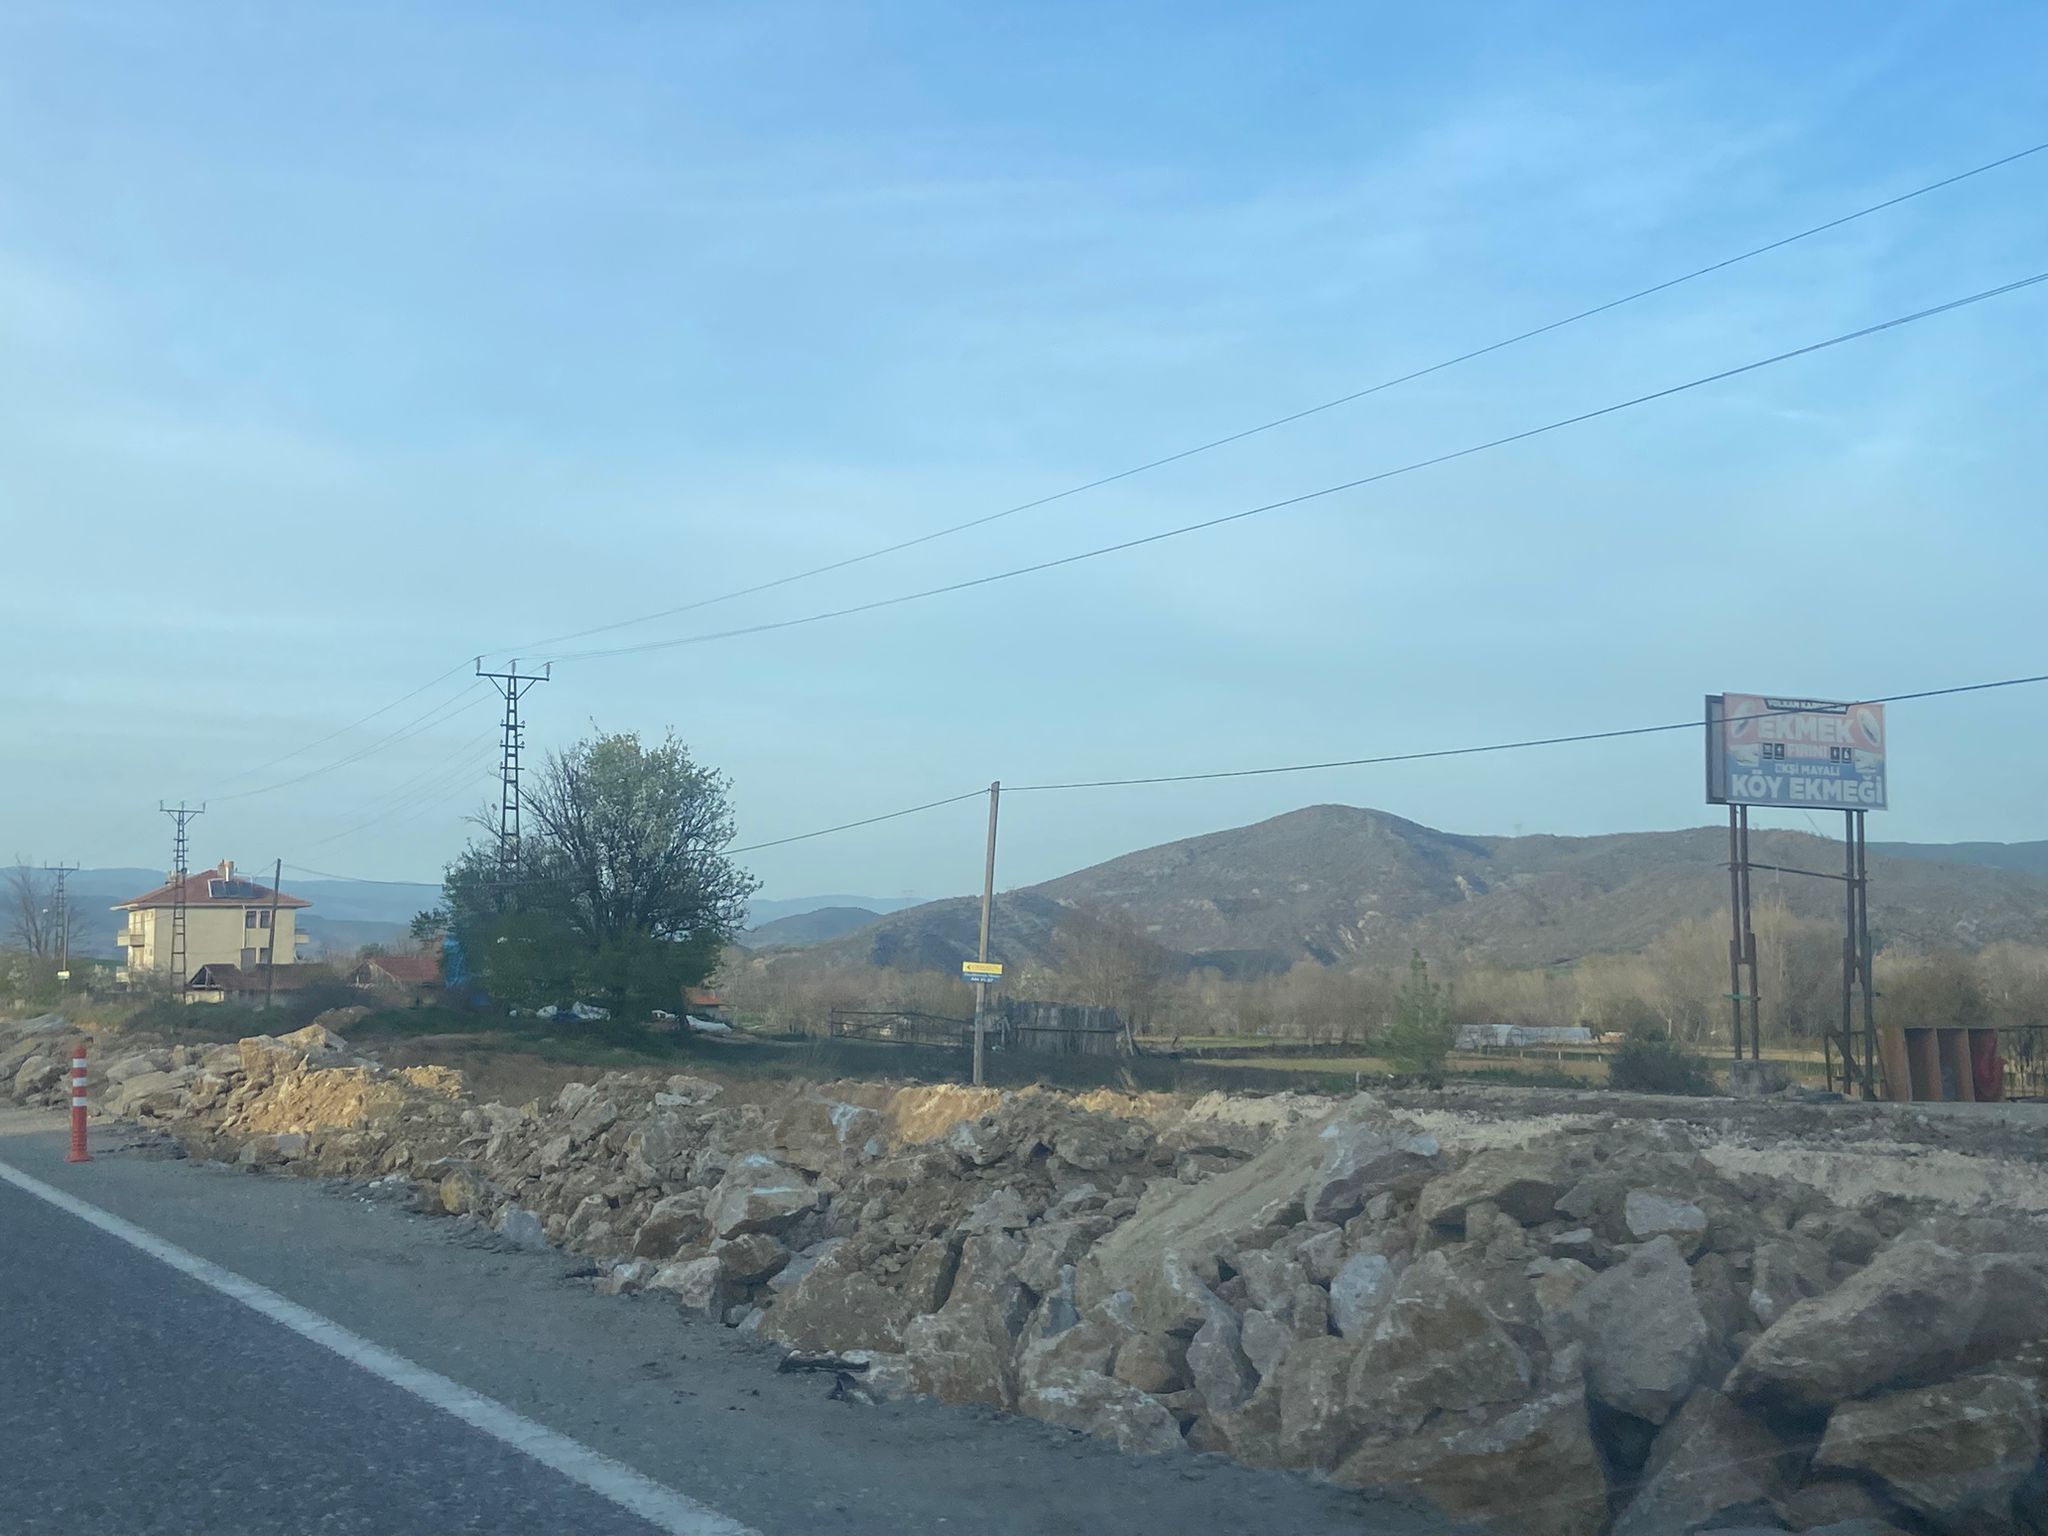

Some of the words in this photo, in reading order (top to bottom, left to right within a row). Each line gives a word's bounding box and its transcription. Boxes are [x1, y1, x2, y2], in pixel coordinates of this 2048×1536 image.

[1758, 714, 1855, 743] EKMEK
[1801, 765, 1840, 777] MAYALI
[1732, 769, 1783, 799] KÖY
[1789, 774, 1884, 805] EKMEĞİ
